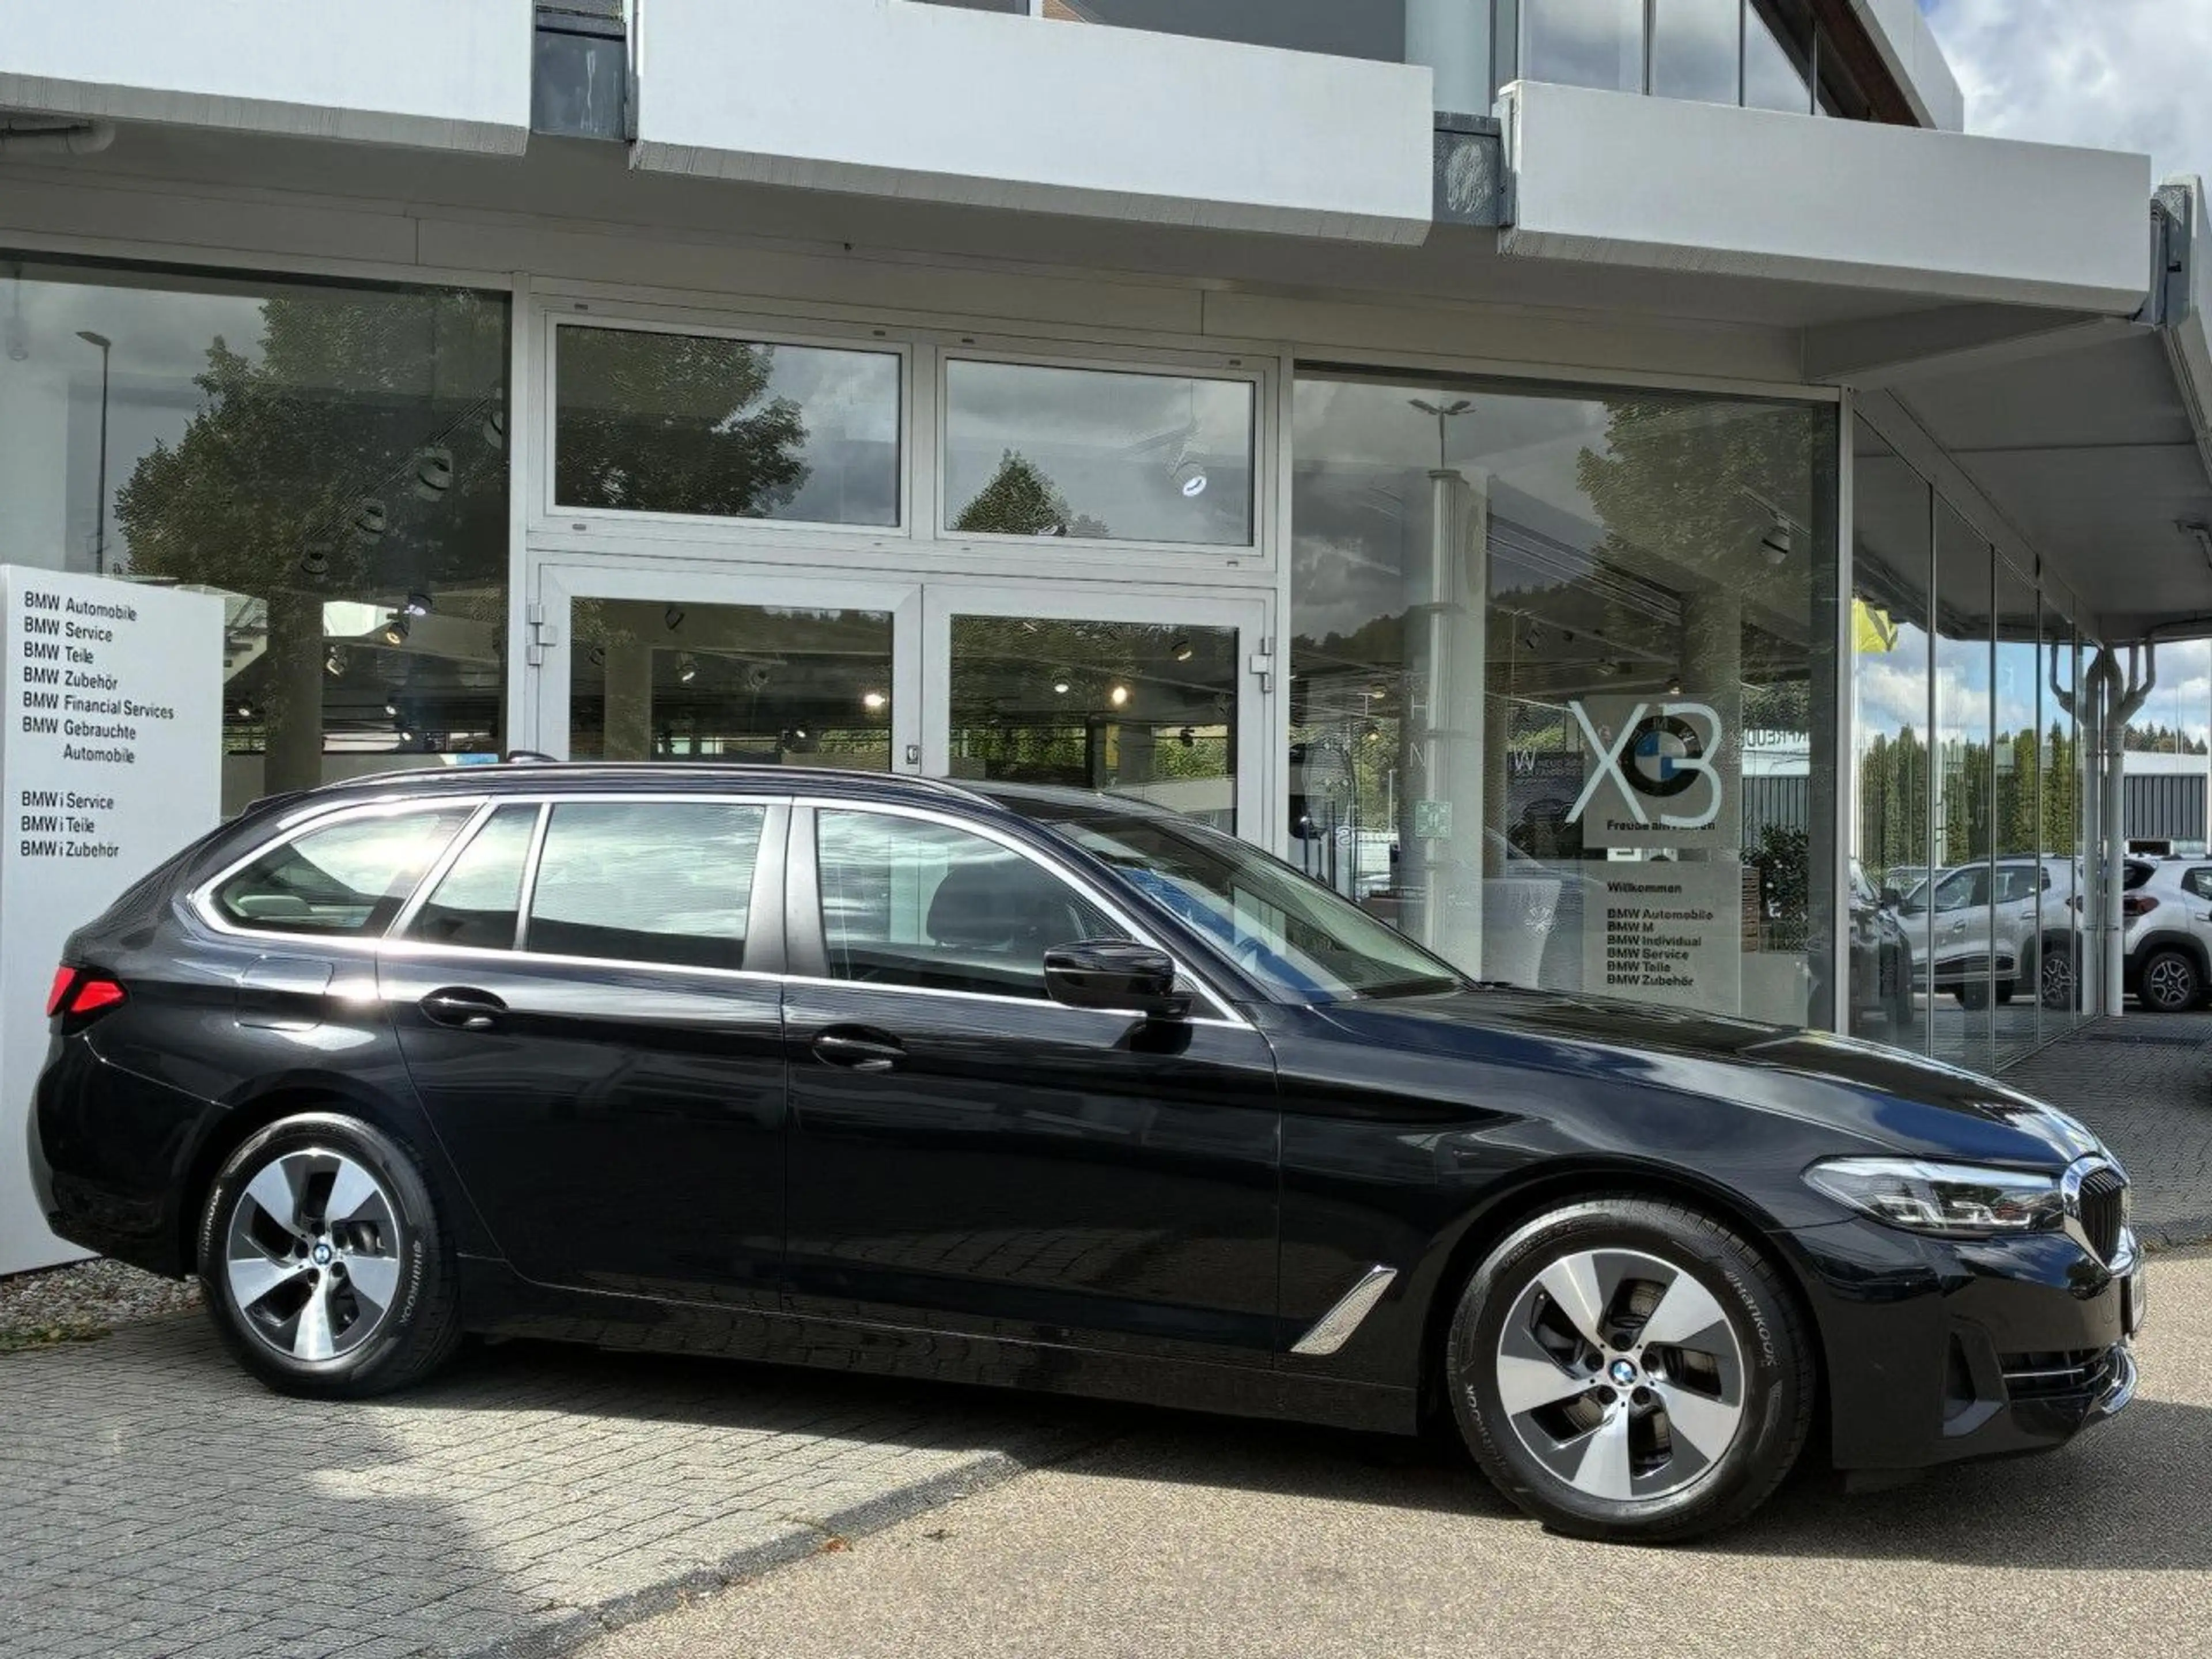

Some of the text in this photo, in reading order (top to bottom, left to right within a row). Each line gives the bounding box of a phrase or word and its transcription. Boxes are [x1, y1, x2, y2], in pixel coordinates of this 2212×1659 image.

[25, 591, 137, 621] BMW Automobile
[24, 616, 113, 642] BMW Service
[24, 641, 94, 664] BMW Teile
[24, 666, 118, 690] BMW Zubehör
[23, 691, 174, 719] BMW Financial Services
[22, 716, 136, 740] BMW Gebrauchte
[63, 744, 135, 763] Automobile
[1565, 700, 1722, 827] X3
[22, 791, 114, 809] BMW i Service
[21, 816, 94, 833] BMW i Teile
[21, 840, 119, 858] BMW i Zubehör
[1607, 881, 1682, 893] Willkommen
[1607, 908, 1714, 921] BMW Automobile
[1607, 922, 1654, 932] BMW M
[1607, 935, 1702, 946] BMW Individual
[1607, 948, 1689, 960] BMW Service
[1607, 961, 1671, 972] BMW Teile
[1607, 974, 1694, 986] BMW Zubehör
